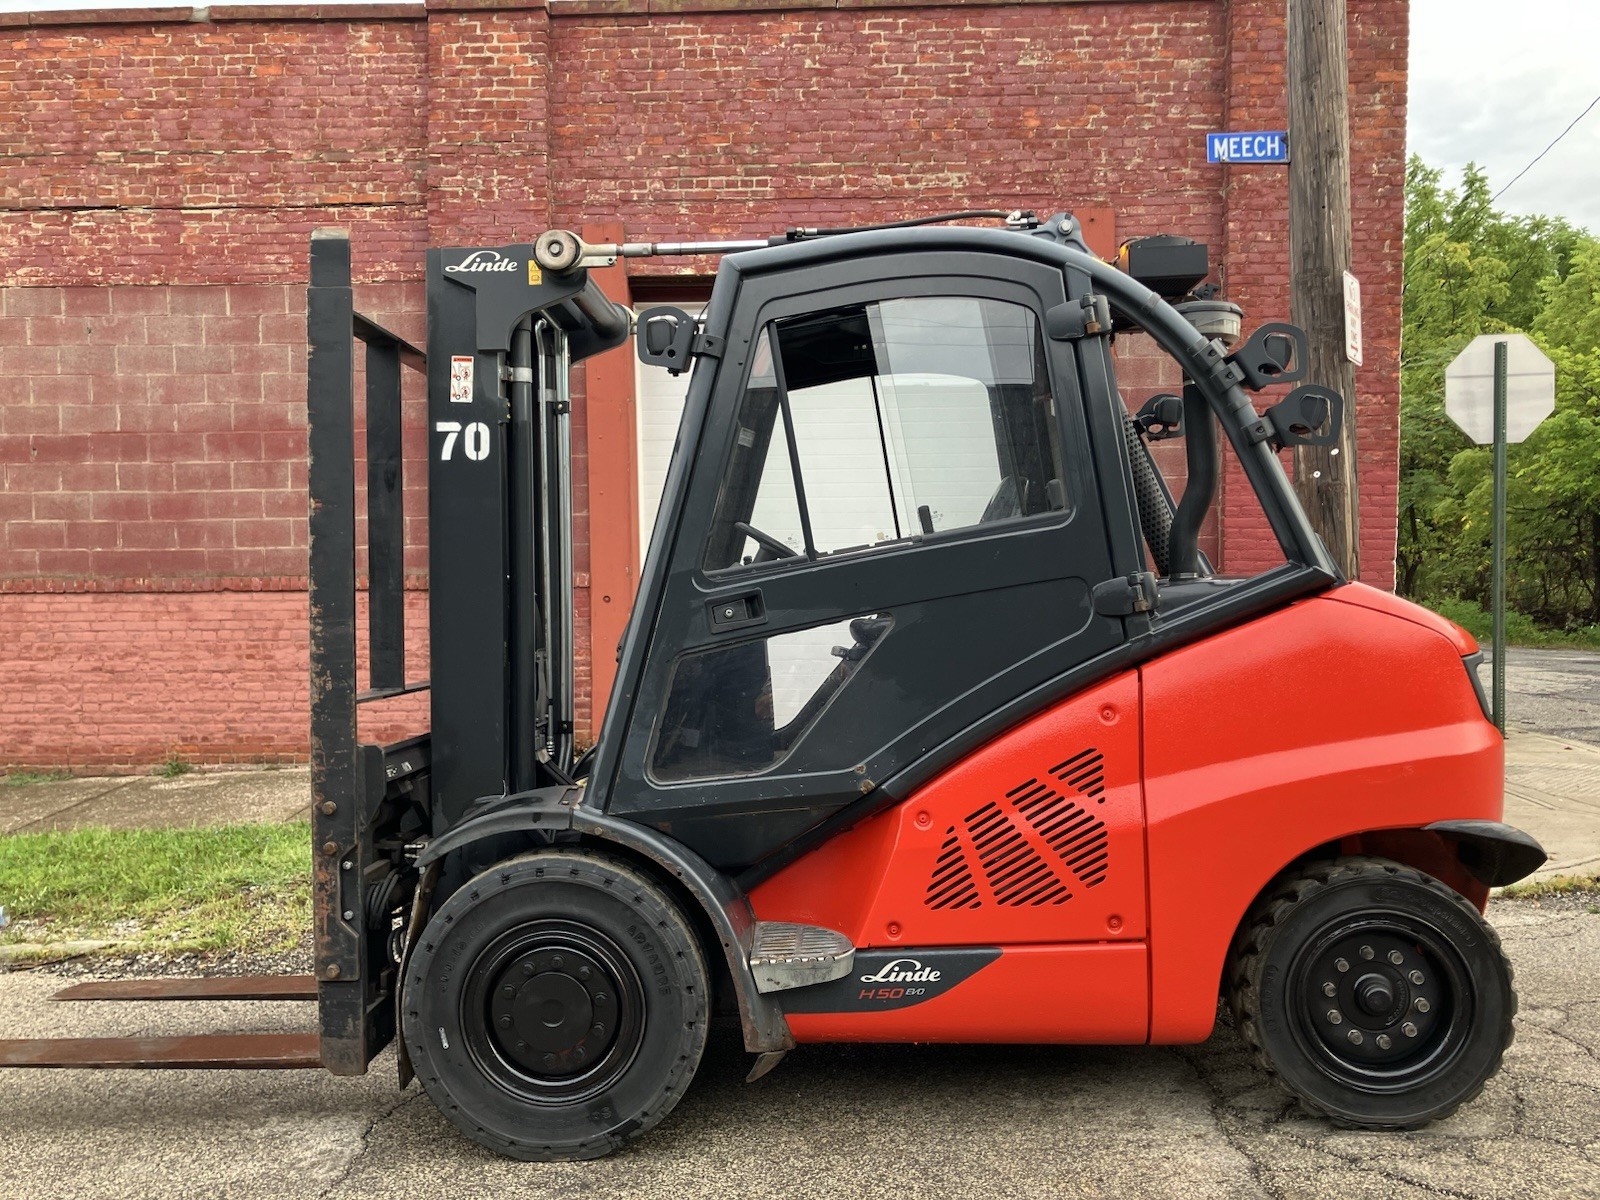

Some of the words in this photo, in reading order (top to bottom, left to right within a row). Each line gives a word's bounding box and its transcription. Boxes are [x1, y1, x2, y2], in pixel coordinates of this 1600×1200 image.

[1213, 135, 1280, 158] MEECH
[444, 250, 518, 273] Linde
[436, 421, 490, 461] 70
[625, 924, 672, 995] ADVANCE
[860, 958, 941, 983] Linde
[905, 987, 926, 996] EVO
